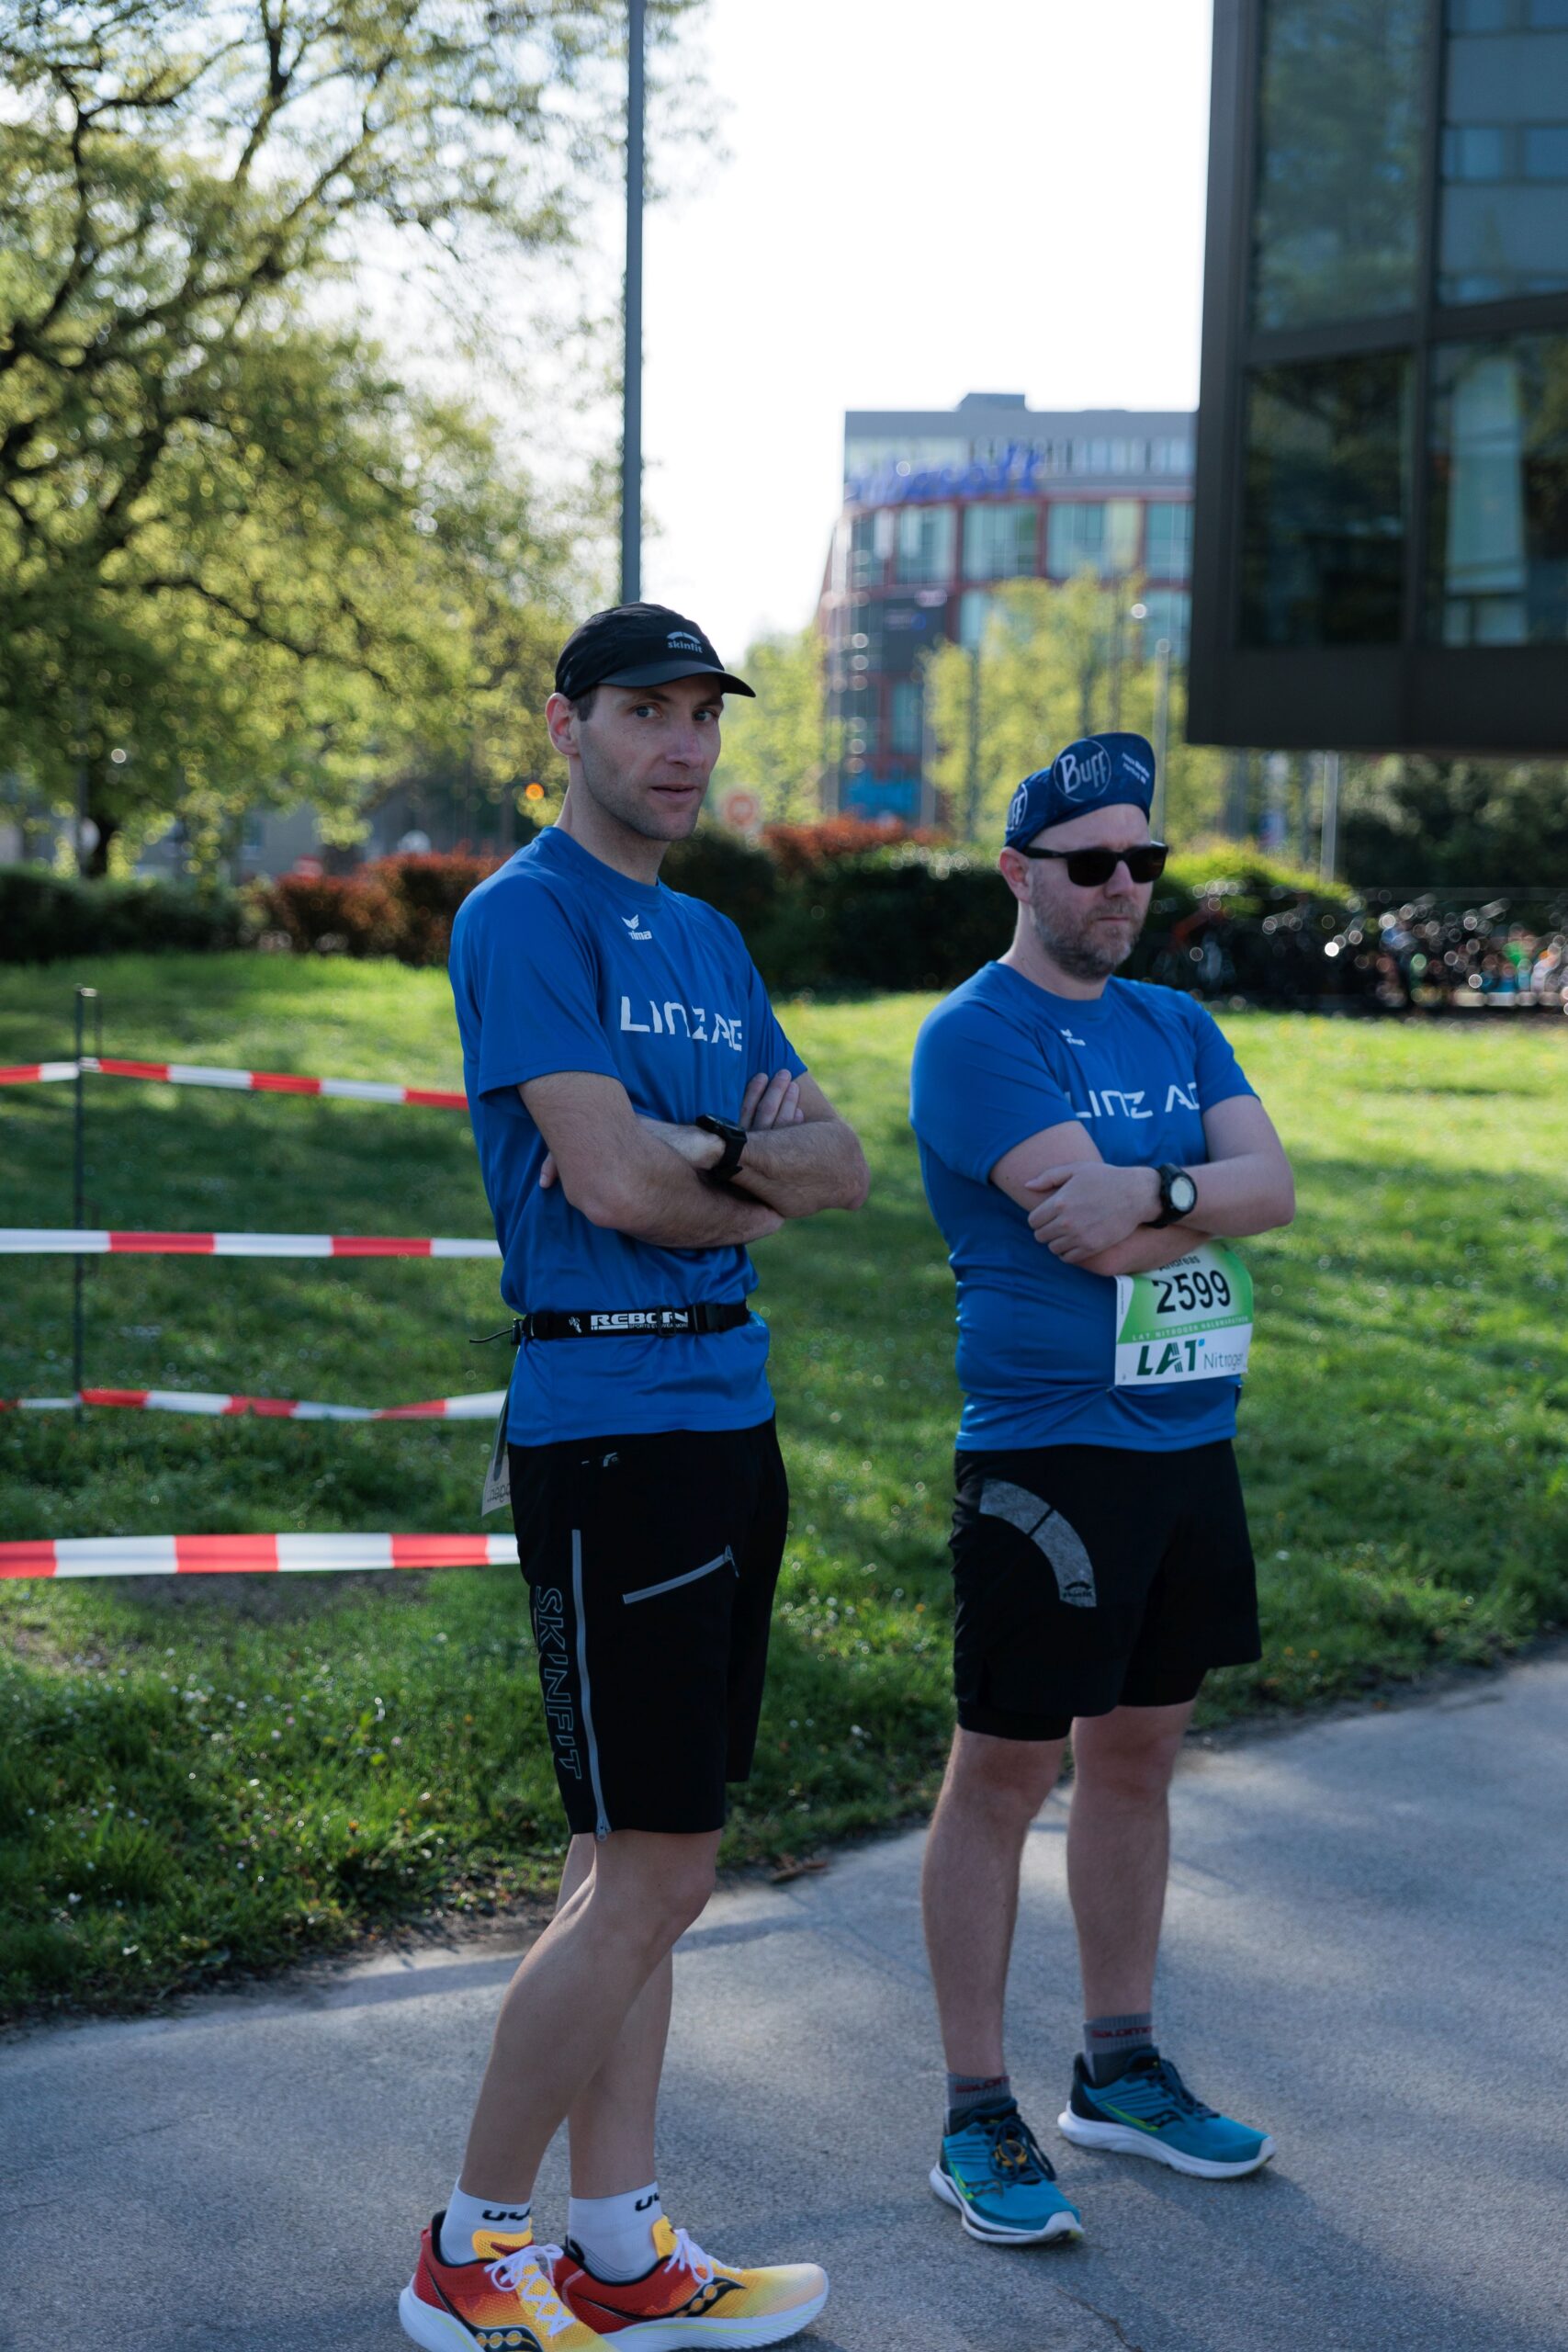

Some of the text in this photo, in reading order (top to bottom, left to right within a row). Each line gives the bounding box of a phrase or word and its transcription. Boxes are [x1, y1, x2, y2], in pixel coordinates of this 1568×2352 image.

[668, 640, 703, 653] skinfit
[1151, 1270, 1232, 1315] 2599
[1132, 1331, 1151, 1341] LAT
[1136, 1340, 1246, 1376] LAT Nitroge
[536, 1585, 581, 1781] SKINFIT
